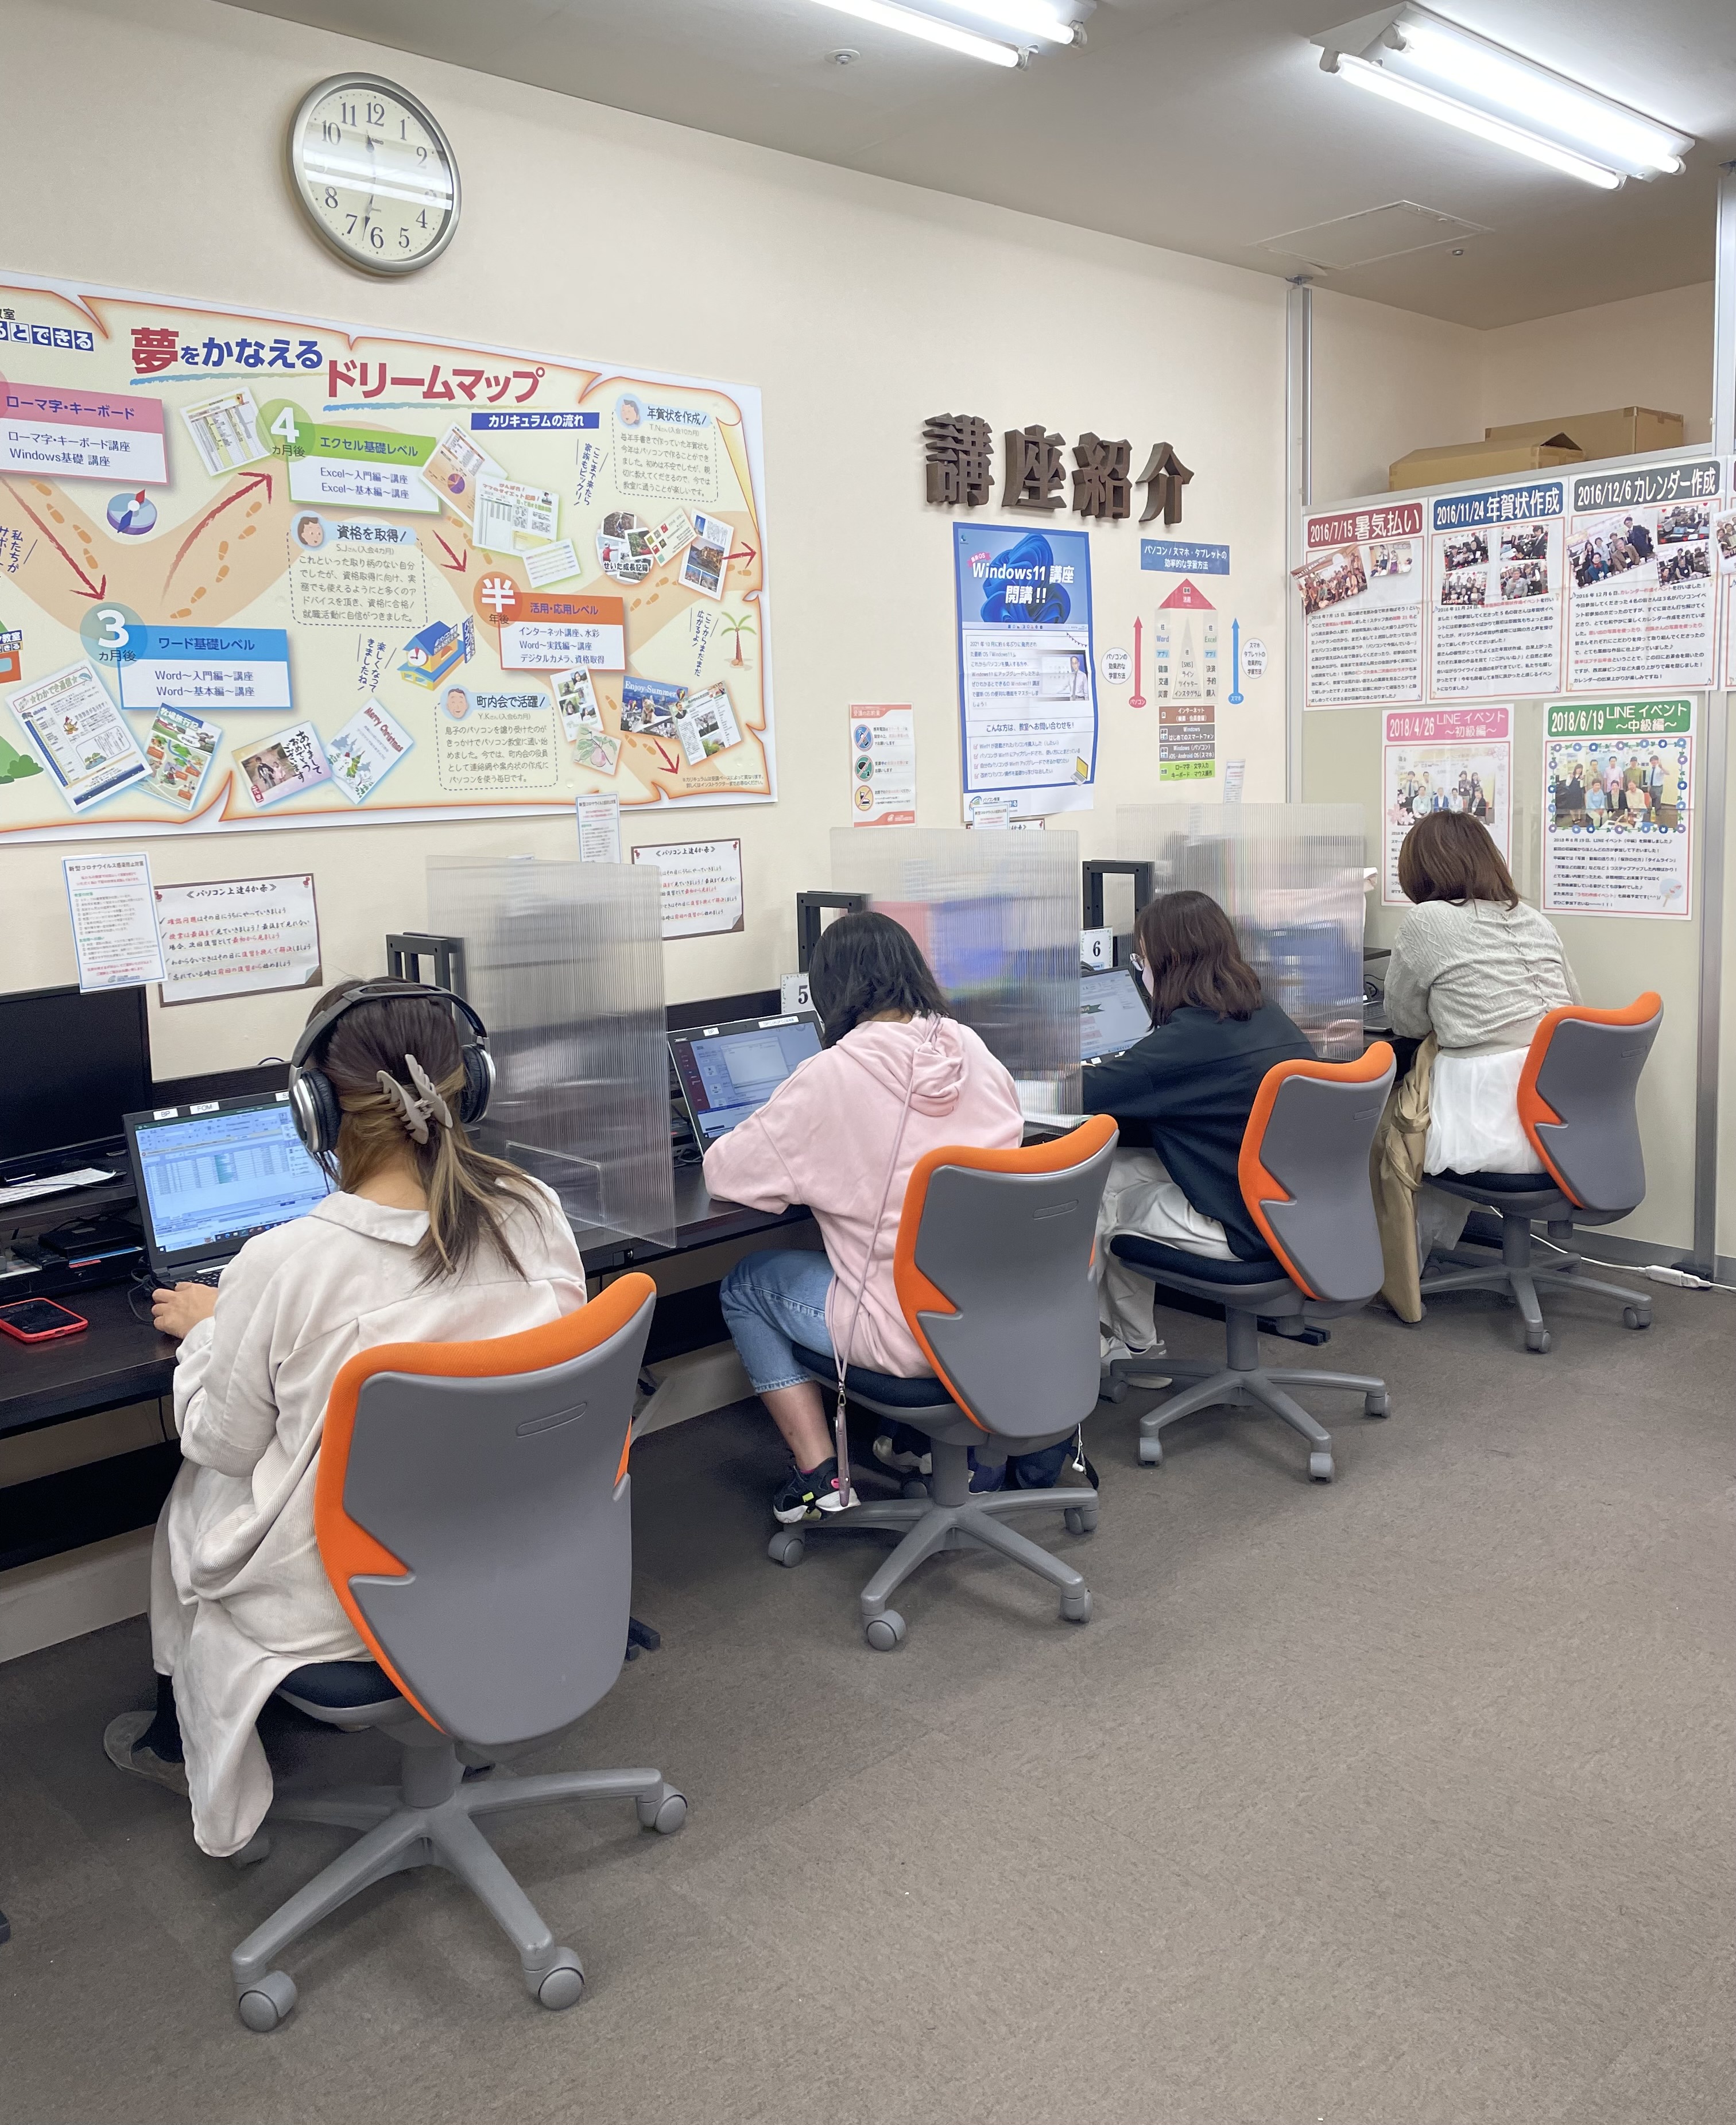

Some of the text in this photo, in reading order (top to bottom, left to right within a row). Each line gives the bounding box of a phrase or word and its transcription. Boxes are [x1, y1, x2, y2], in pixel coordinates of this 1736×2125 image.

[341, 102, 357, 127] 11
[366, 102, 385, 127] 12
[321, 120, 340, 145] 10
[400, 119, 407, 141] 1
[416, 146, 428, 169] 2
[325, 187, 338, 208] 8
[346, 214, 358, 234] 7
[416, 208, 428, 228] 4
[370, 227, 384, 248] 6
[398, 227, 410, 248] 5
[130, 327, 323, 374] 夢をかなえる
[328, 359, 545, 404] ドリームマップ
[6, 396, 134, 420] ローマ字・キーボード
[270, 407, 299, 444] 4
[488, 414, 584, 429] カリキュラムの流れ
[8, 432, 131, 452] ローマ字・キーボード講座
[320, 435, 418, 457] エクセル基礎レベル
[621, 432, 709, 451] 毎年手書きで作っていた年賀状も
[9, 448, 110, 467] Windows基礎 講座
[621, 445, 709, 462] 今年はパソコンで作ることができ
[622, 457, 710, 475] ました。初めは不安でしたが、親
[923, 413, 1194, 525] 講座紹介
[584, 447, 600, 506] ここまで来たら
[622, 469, 710, 485] 切に教えてくださるので、今では
[623, 481, 704, 497] 教室に通うことが楽しいです。
[1578, 466, 1716, 506] 2016/12/6 カレンダー作成
[1436, 487, 1560, 526] 2016/11/24 年賀状作成
[1310, 509, 1420, 544] 2016/7/15 暑気払い
[7, 530, 23, 573] 私たちが
[299, 556, 415, 571] これといった取り柄のない自分
[1164, 559, 1208, 569] 効率的な学習方法
[300, 569, 416, 583] でしたが、資格取得に向け、実
[972, 562, 1075, 584] Windows11 講座
[301, 583, 416, 596] 務でも使えるようにと多くのア
[482, 578, 516, 613] 半
[303, 610, 412, 622] 就職活動に自信がつきました。
[530, 602, 599, 615] 活用・応用レベル
[489, 613, 510, 625] 年後
[96, 609, 129, 649] 3
[519, 627, 600, 638] インターネット講座、水彩
[158, 637, 254, 651] ワード基礎レベル
[695, 613, 712, 677] ここからまだまだ
[1156, 635, 1169, 643] Word
[520, 654, 604, 665] デジタルカメラ、資格取得
[1106, 653, 1127, 661] パソコンの
[1244, 650, 1266, 658] タブレットの
[369, 642, 386, 693] 楽しくなって
[1109, 662, 1125, 670] 効果的な
[1206, 665, 1216, 673] 決済
[625, 680, 645, 693] Enjoy
[647, 684, 677, 698] Summer
[1158, 677, 1169, 686] 交通
[1158, 690, 1168, 698] 災害
[1436, 712, 1506, 726] LINE イベント
[1606, 703, 1688, 719] LINE イベント
[363, 707, 382, 727] Merry
[380, 723, 404, 753] Christmas
[445, 726, 547, 735] 息子のパソコンを譲り受けたのが
[986, 722, 1074, 732] こんな方は、教室へお問い合わせを！
[1390, 718, 1435, 738] 2018/4/26
[1552, 710, 1604, 733] 2018/6/19
[1615, 718, 1677, 733] ～中級編～
[1444, 726, 1497, 738] ～初級編～
[446, 737, 548, 747] きっかけでパソコン教室に通い始
[447, 749, 548, 759] めました。今では、町内会の役員
[448, 762, 549, 771] として連絡網や案内状の作成に
[449, 775, 526, 784] パソコンを使う毎日です。
[1092, 940, 1101, 957] 6
[798, 985, 808, 1004] 5
